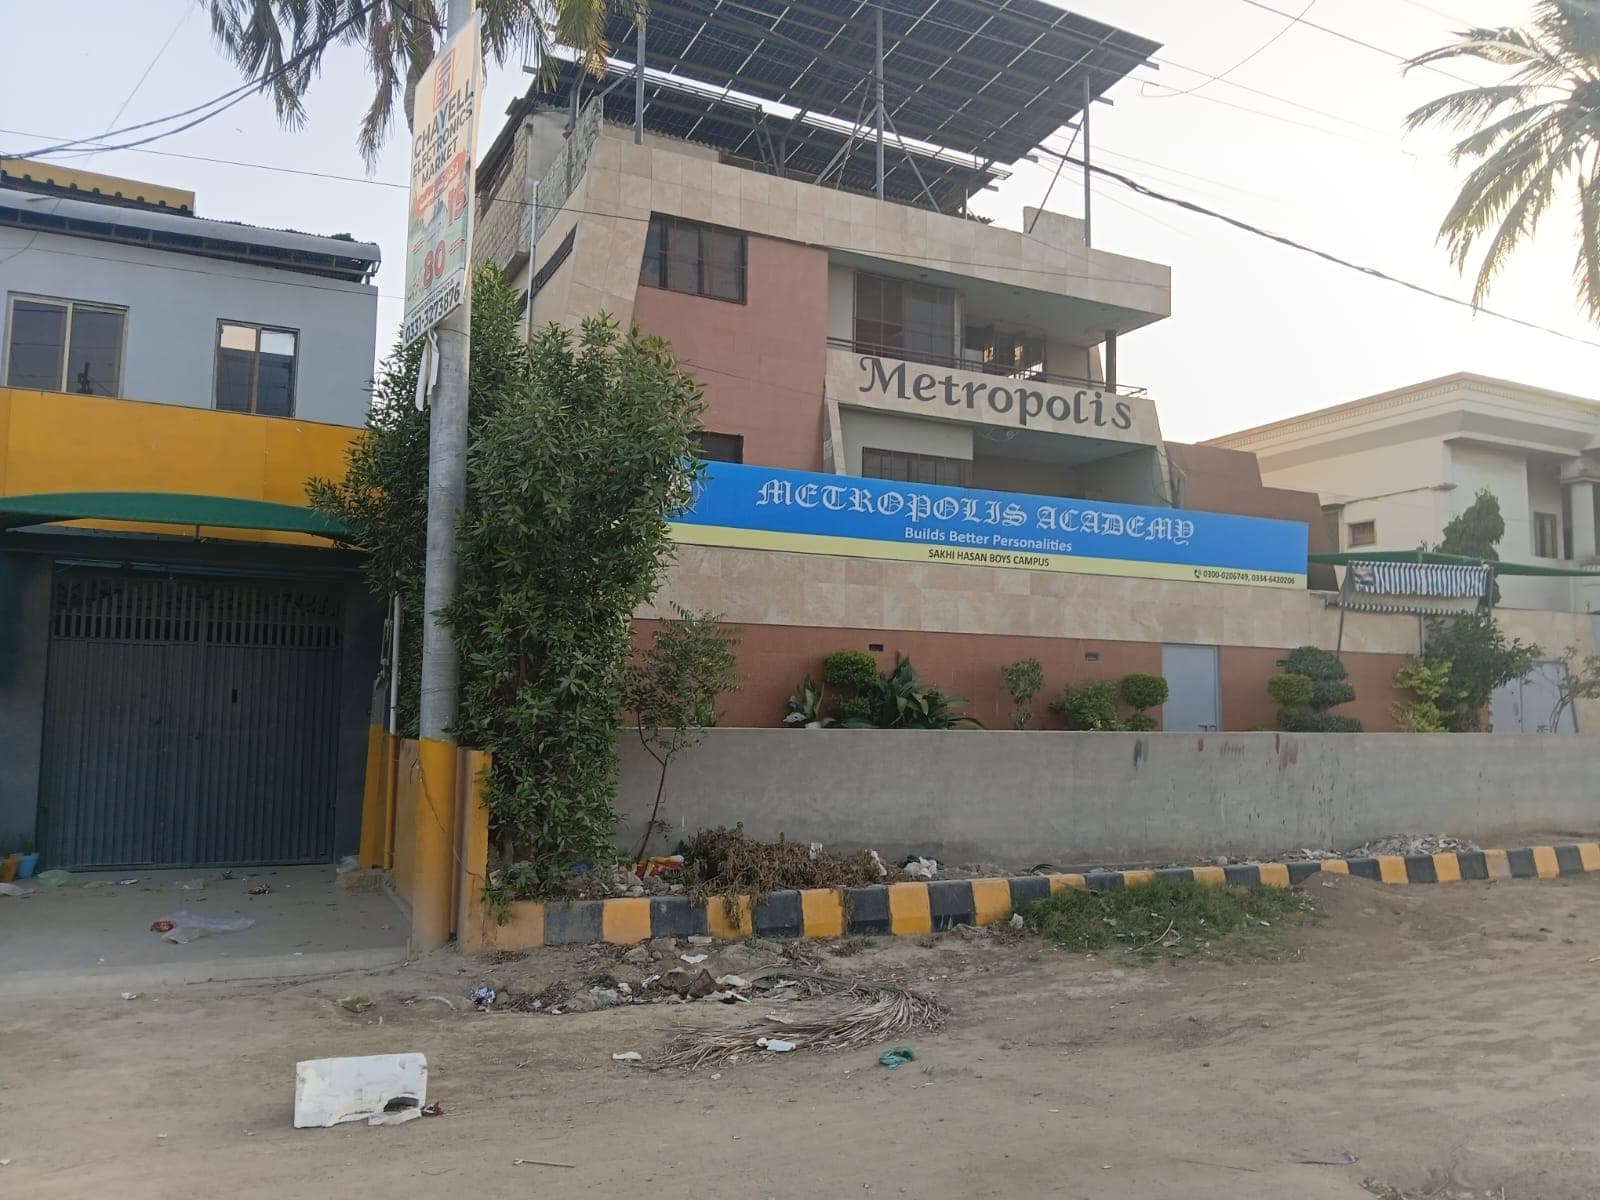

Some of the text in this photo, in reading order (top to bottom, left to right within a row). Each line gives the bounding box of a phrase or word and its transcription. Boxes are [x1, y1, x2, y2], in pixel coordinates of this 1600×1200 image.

[413, 101, 472, 178] ELECTRONICS
[415, 79, 474, 159] CHAYELL
[422, 136, 458, 187] MARKET
[423, 240, 446, 289] 80
[405, 281, 460, 344] 0331-3273876
[859, 356, 1132, 430] Metropolis
[756, 479, 1195, 545] METROPOLIS ACADEMY
[905, 527, 1073, 552] Builds Better Personalities
[928, 548, 1050, 567] SAKHI HASAN BOYS CAMPUS
